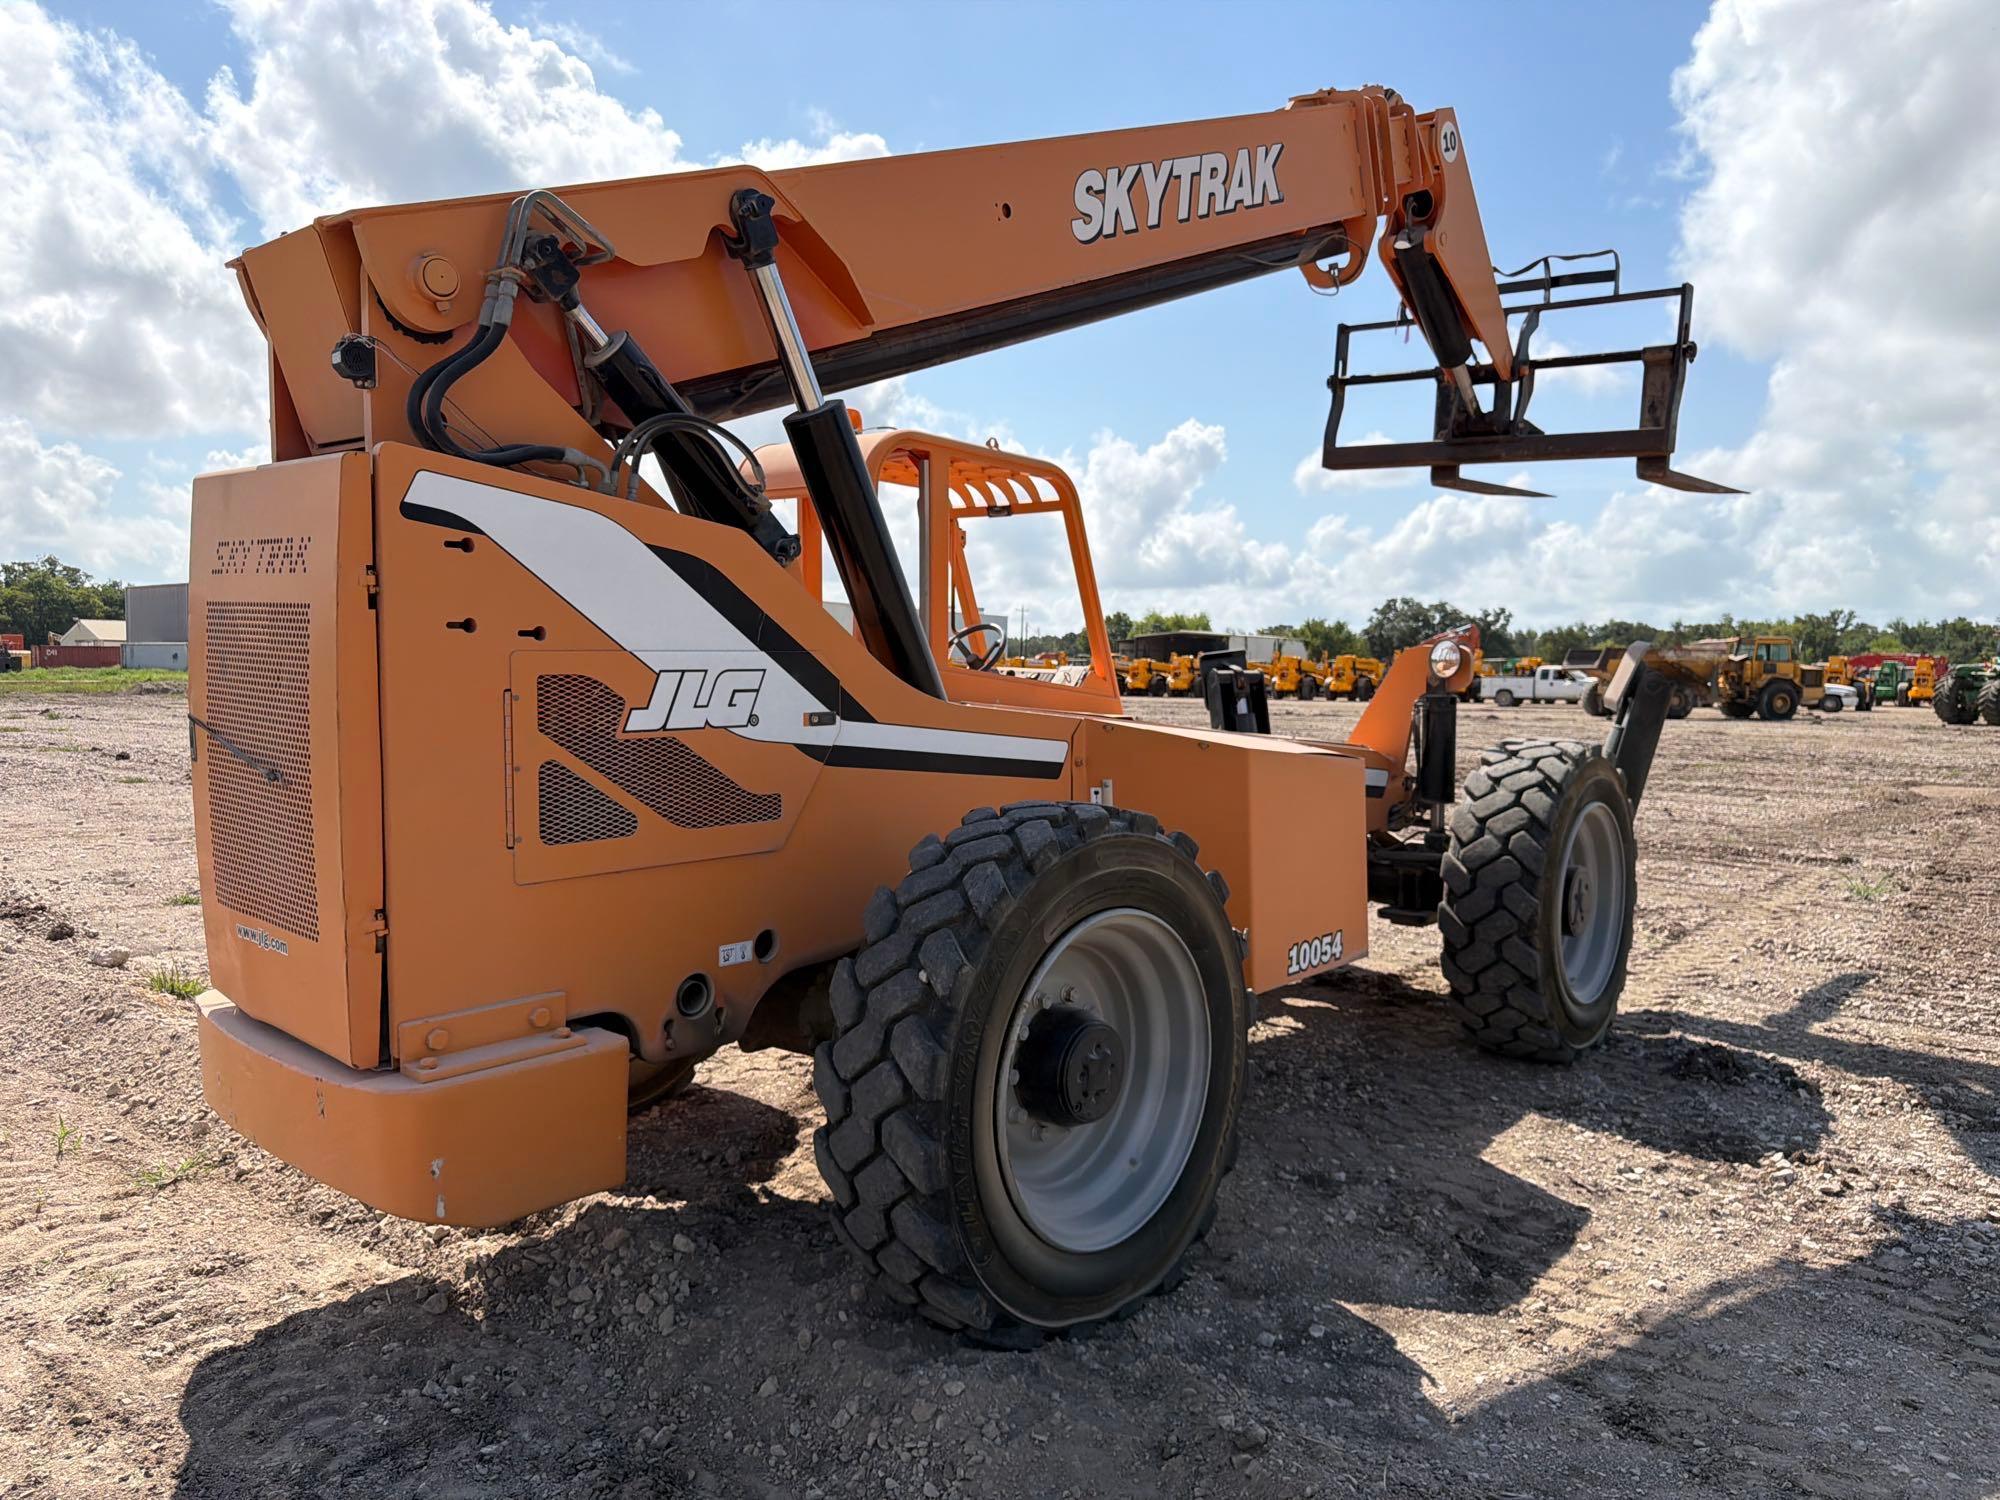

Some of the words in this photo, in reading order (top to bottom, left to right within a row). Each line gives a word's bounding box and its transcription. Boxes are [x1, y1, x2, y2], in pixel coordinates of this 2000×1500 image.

[1443, 130, 1457, 152] 10
[1071, 143, 1284, 245] SKYTRAK
[622, 669, 766, 733] JLG
[236, 923, 289, 956] www.jlg.com
[1287, 929, 1344, 977] 10054
